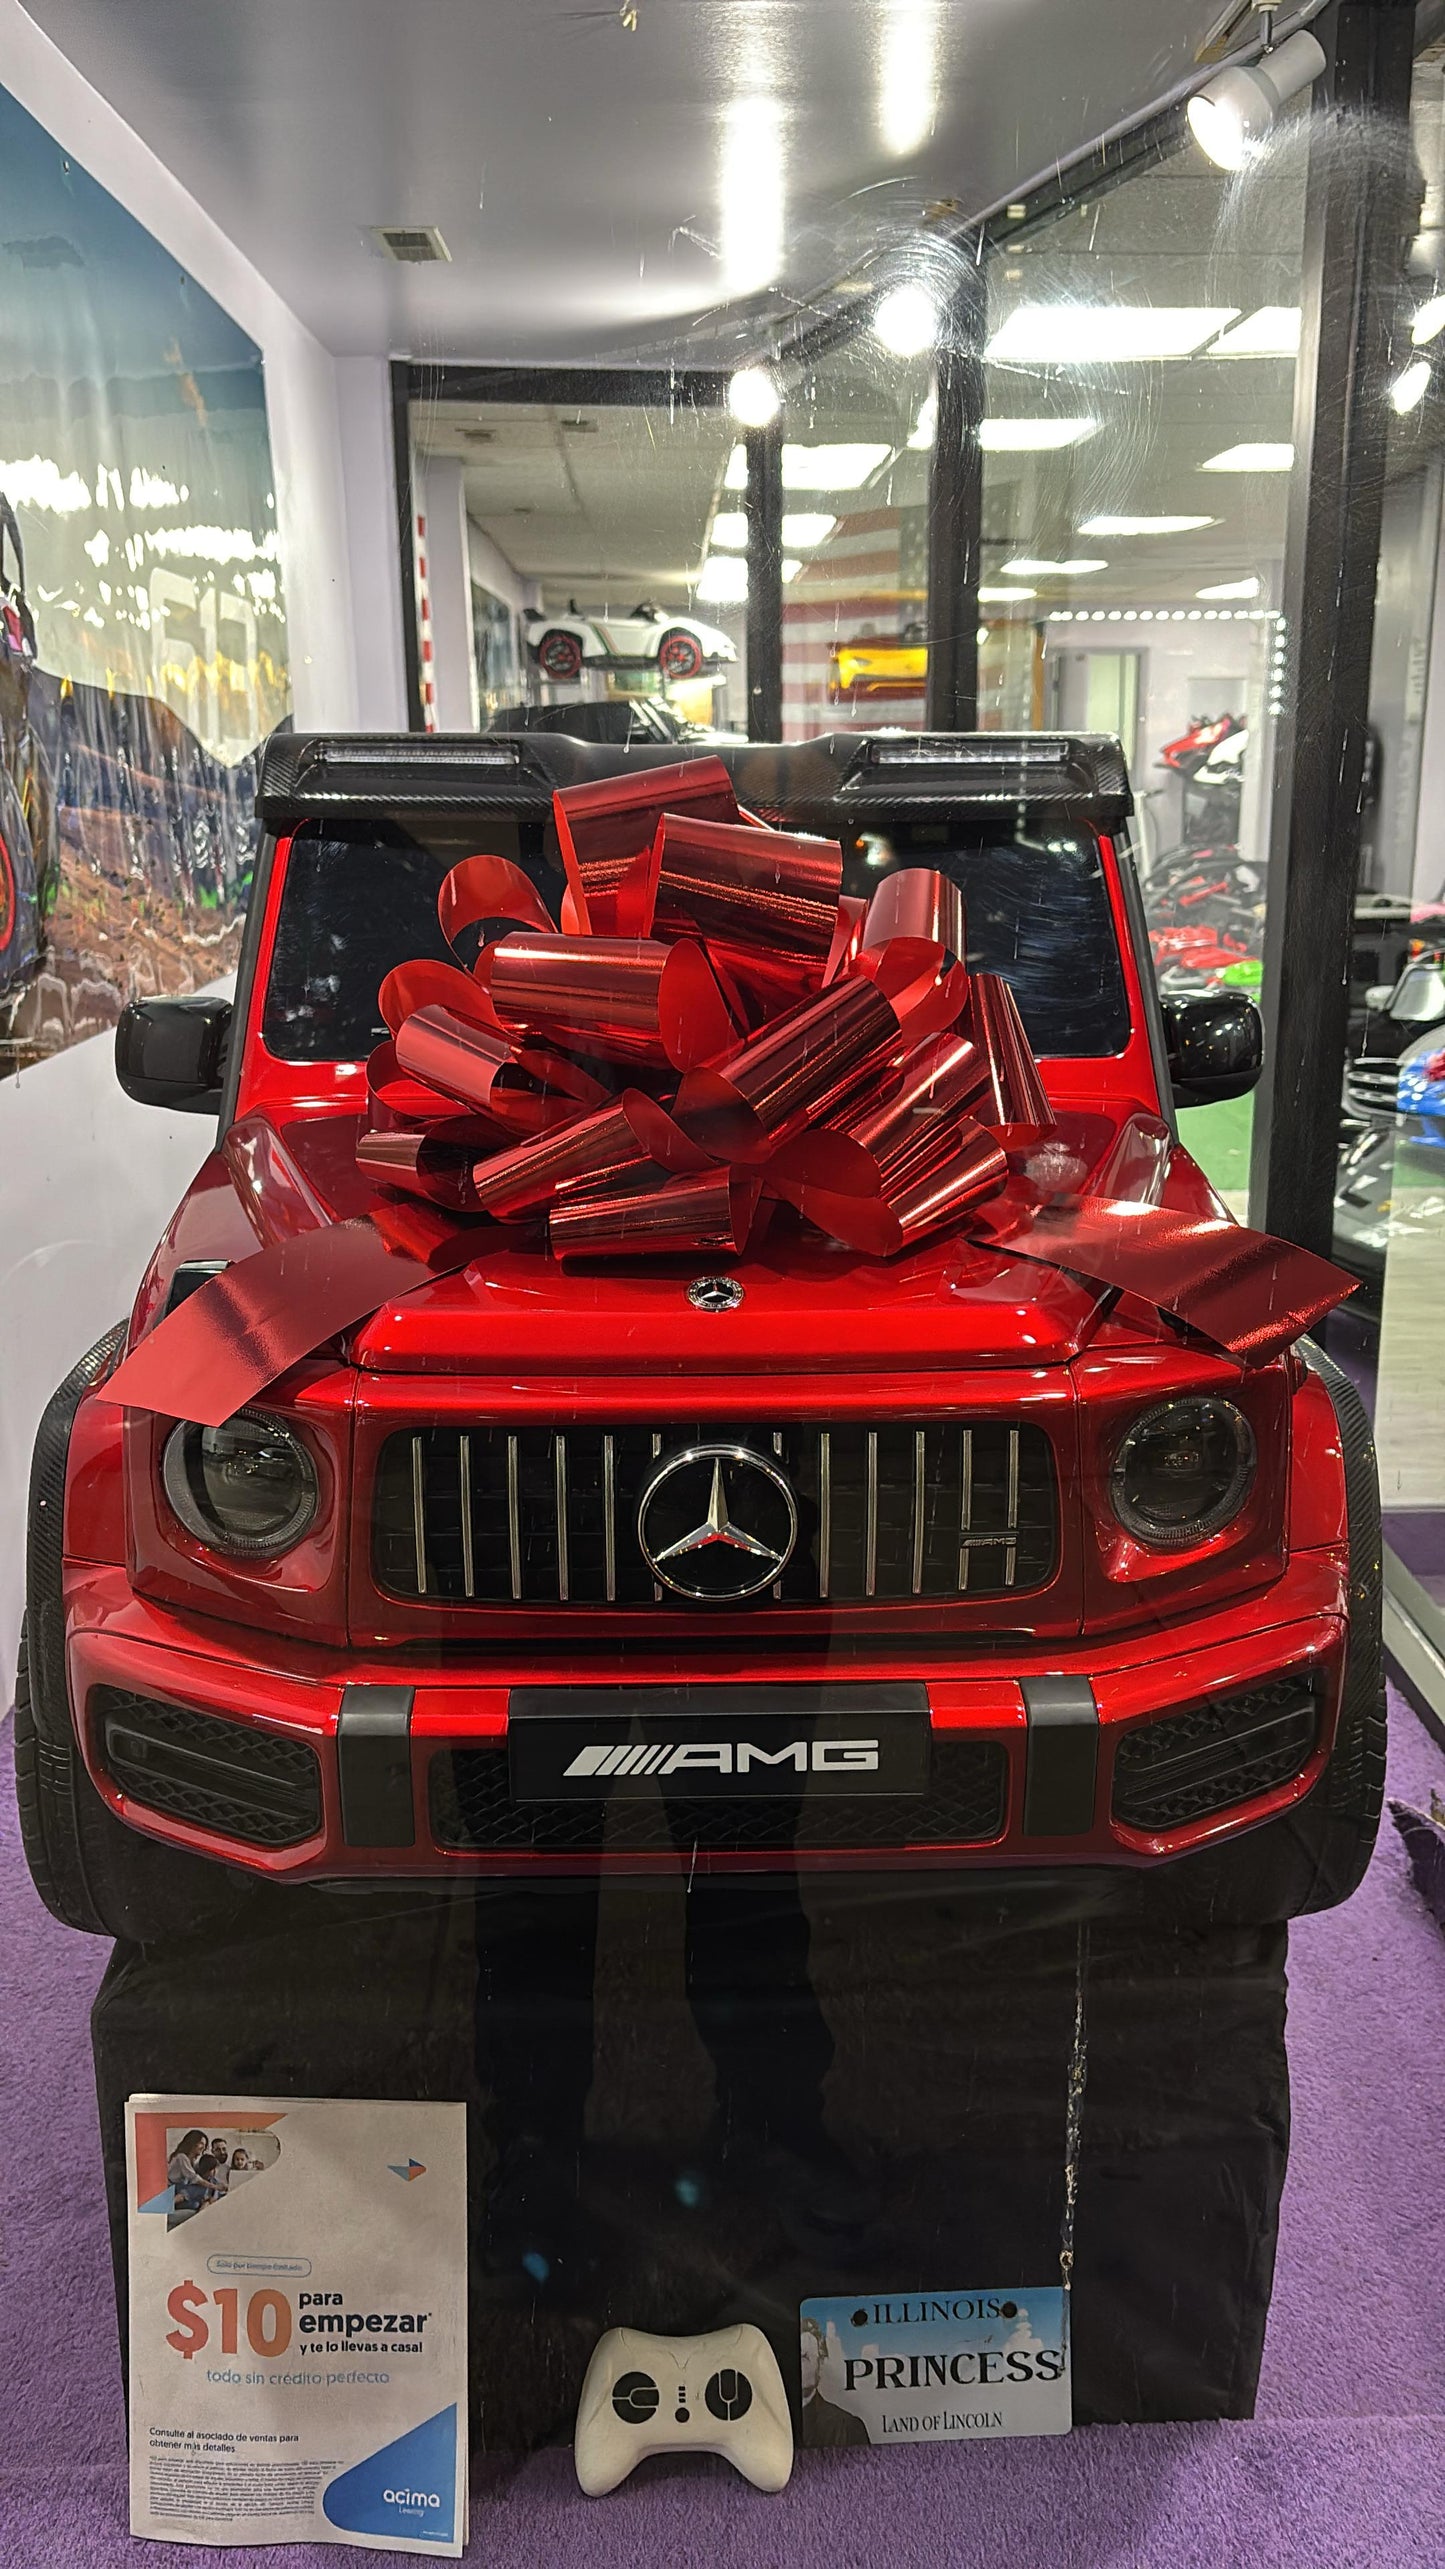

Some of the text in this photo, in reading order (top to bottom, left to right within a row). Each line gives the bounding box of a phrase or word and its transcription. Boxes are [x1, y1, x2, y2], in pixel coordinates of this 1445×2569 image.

[299, 2292, 343, 2310] para
[165, 2280, 292, 2360] $10
[873, 2297, 1000, 2325] ILLINOIS
[300, 2344, 308, 2356] y
[310, 2343, 323, 2353] te
[326, 2341, 339, 2353] lo
[341, 2340, 379, 2352] llevas
[380, 2343, 389, 2353] a
[207, 2369, 390, 2387] todo sin crédito perfecto
[843, 2350, 1063, 2391] PRINCESS
[149, 2427, 299, 2444] Consulte al asociado de ventas para
[149, 2439, 182, 2450] obtener
[202, 2443, 236, 2453] detalles
[383, 2488, 440, 2508] acima
